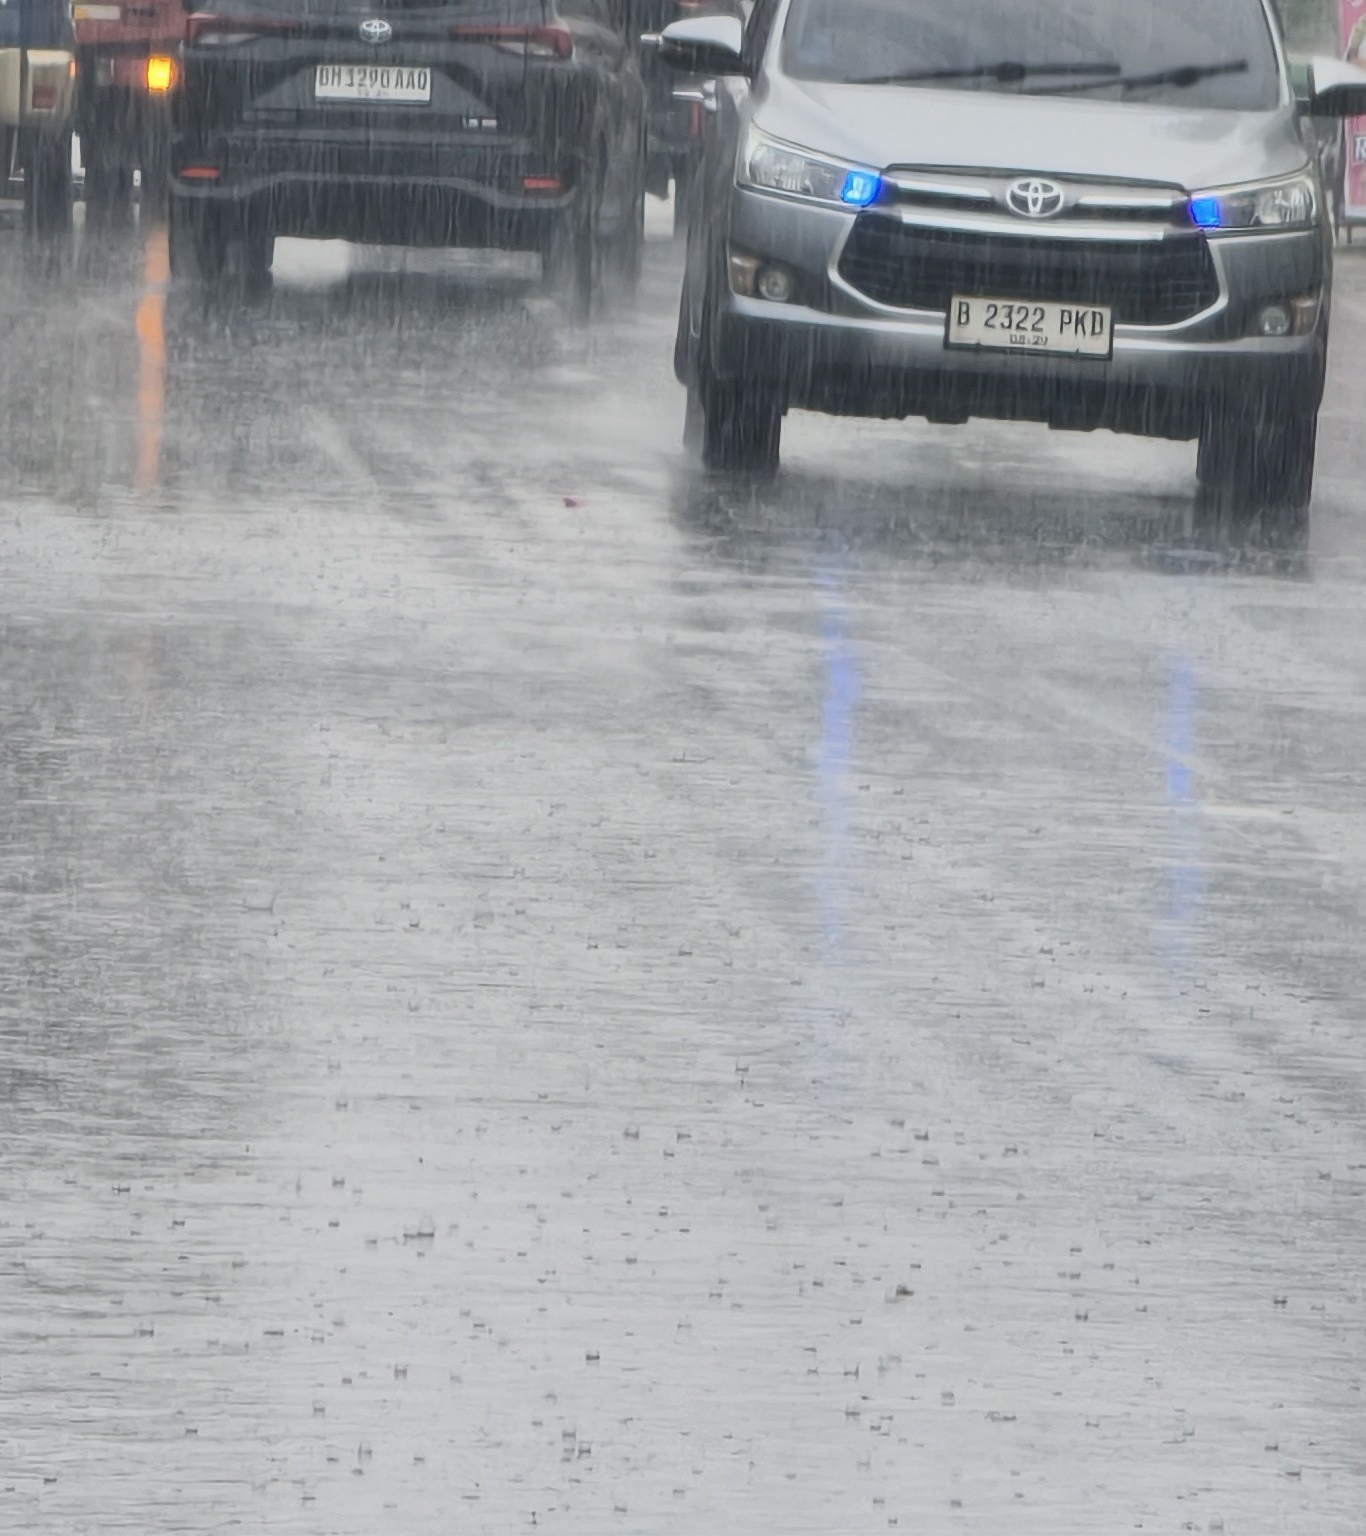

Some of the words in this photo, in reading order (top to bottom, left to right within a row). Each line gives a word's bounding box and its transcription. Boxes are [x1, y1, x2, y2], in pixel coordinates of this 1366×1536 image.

[957, 300, 971, 327] B
[984, 303, 1046, 333] 2322
[1060, 308, 1105, 338] PKD
